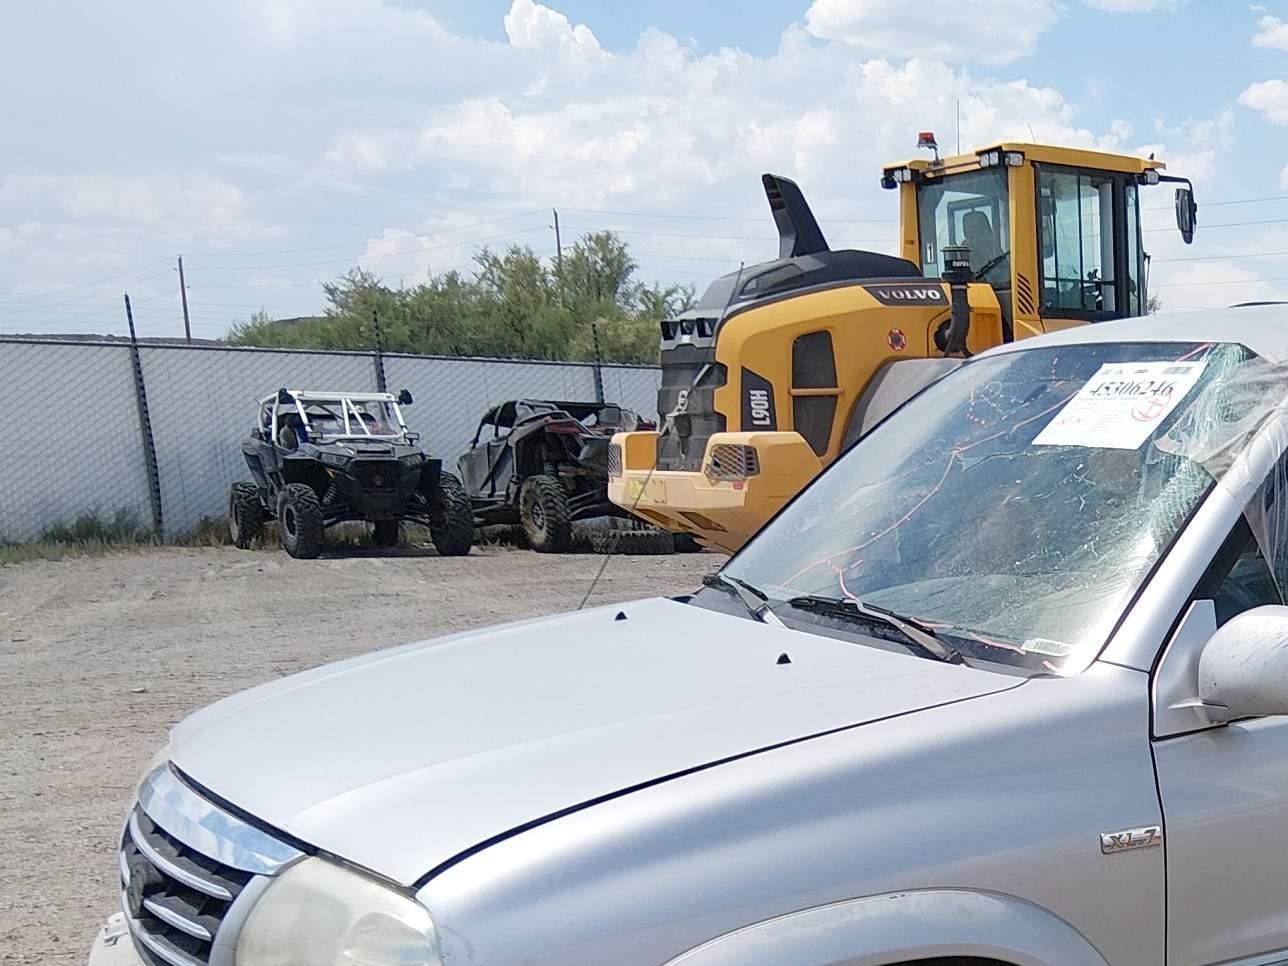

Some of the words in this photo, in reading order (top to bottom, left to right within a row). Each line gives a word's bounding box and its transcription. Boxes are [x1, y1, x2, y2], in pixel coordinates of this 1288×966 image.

[878, 288, 941, 300] VOLVO
[1090, 380, 1178, 396] 45306246
[749, 389, 771, 426] L90H
[1108, 828, 1157, 849] XL-7
